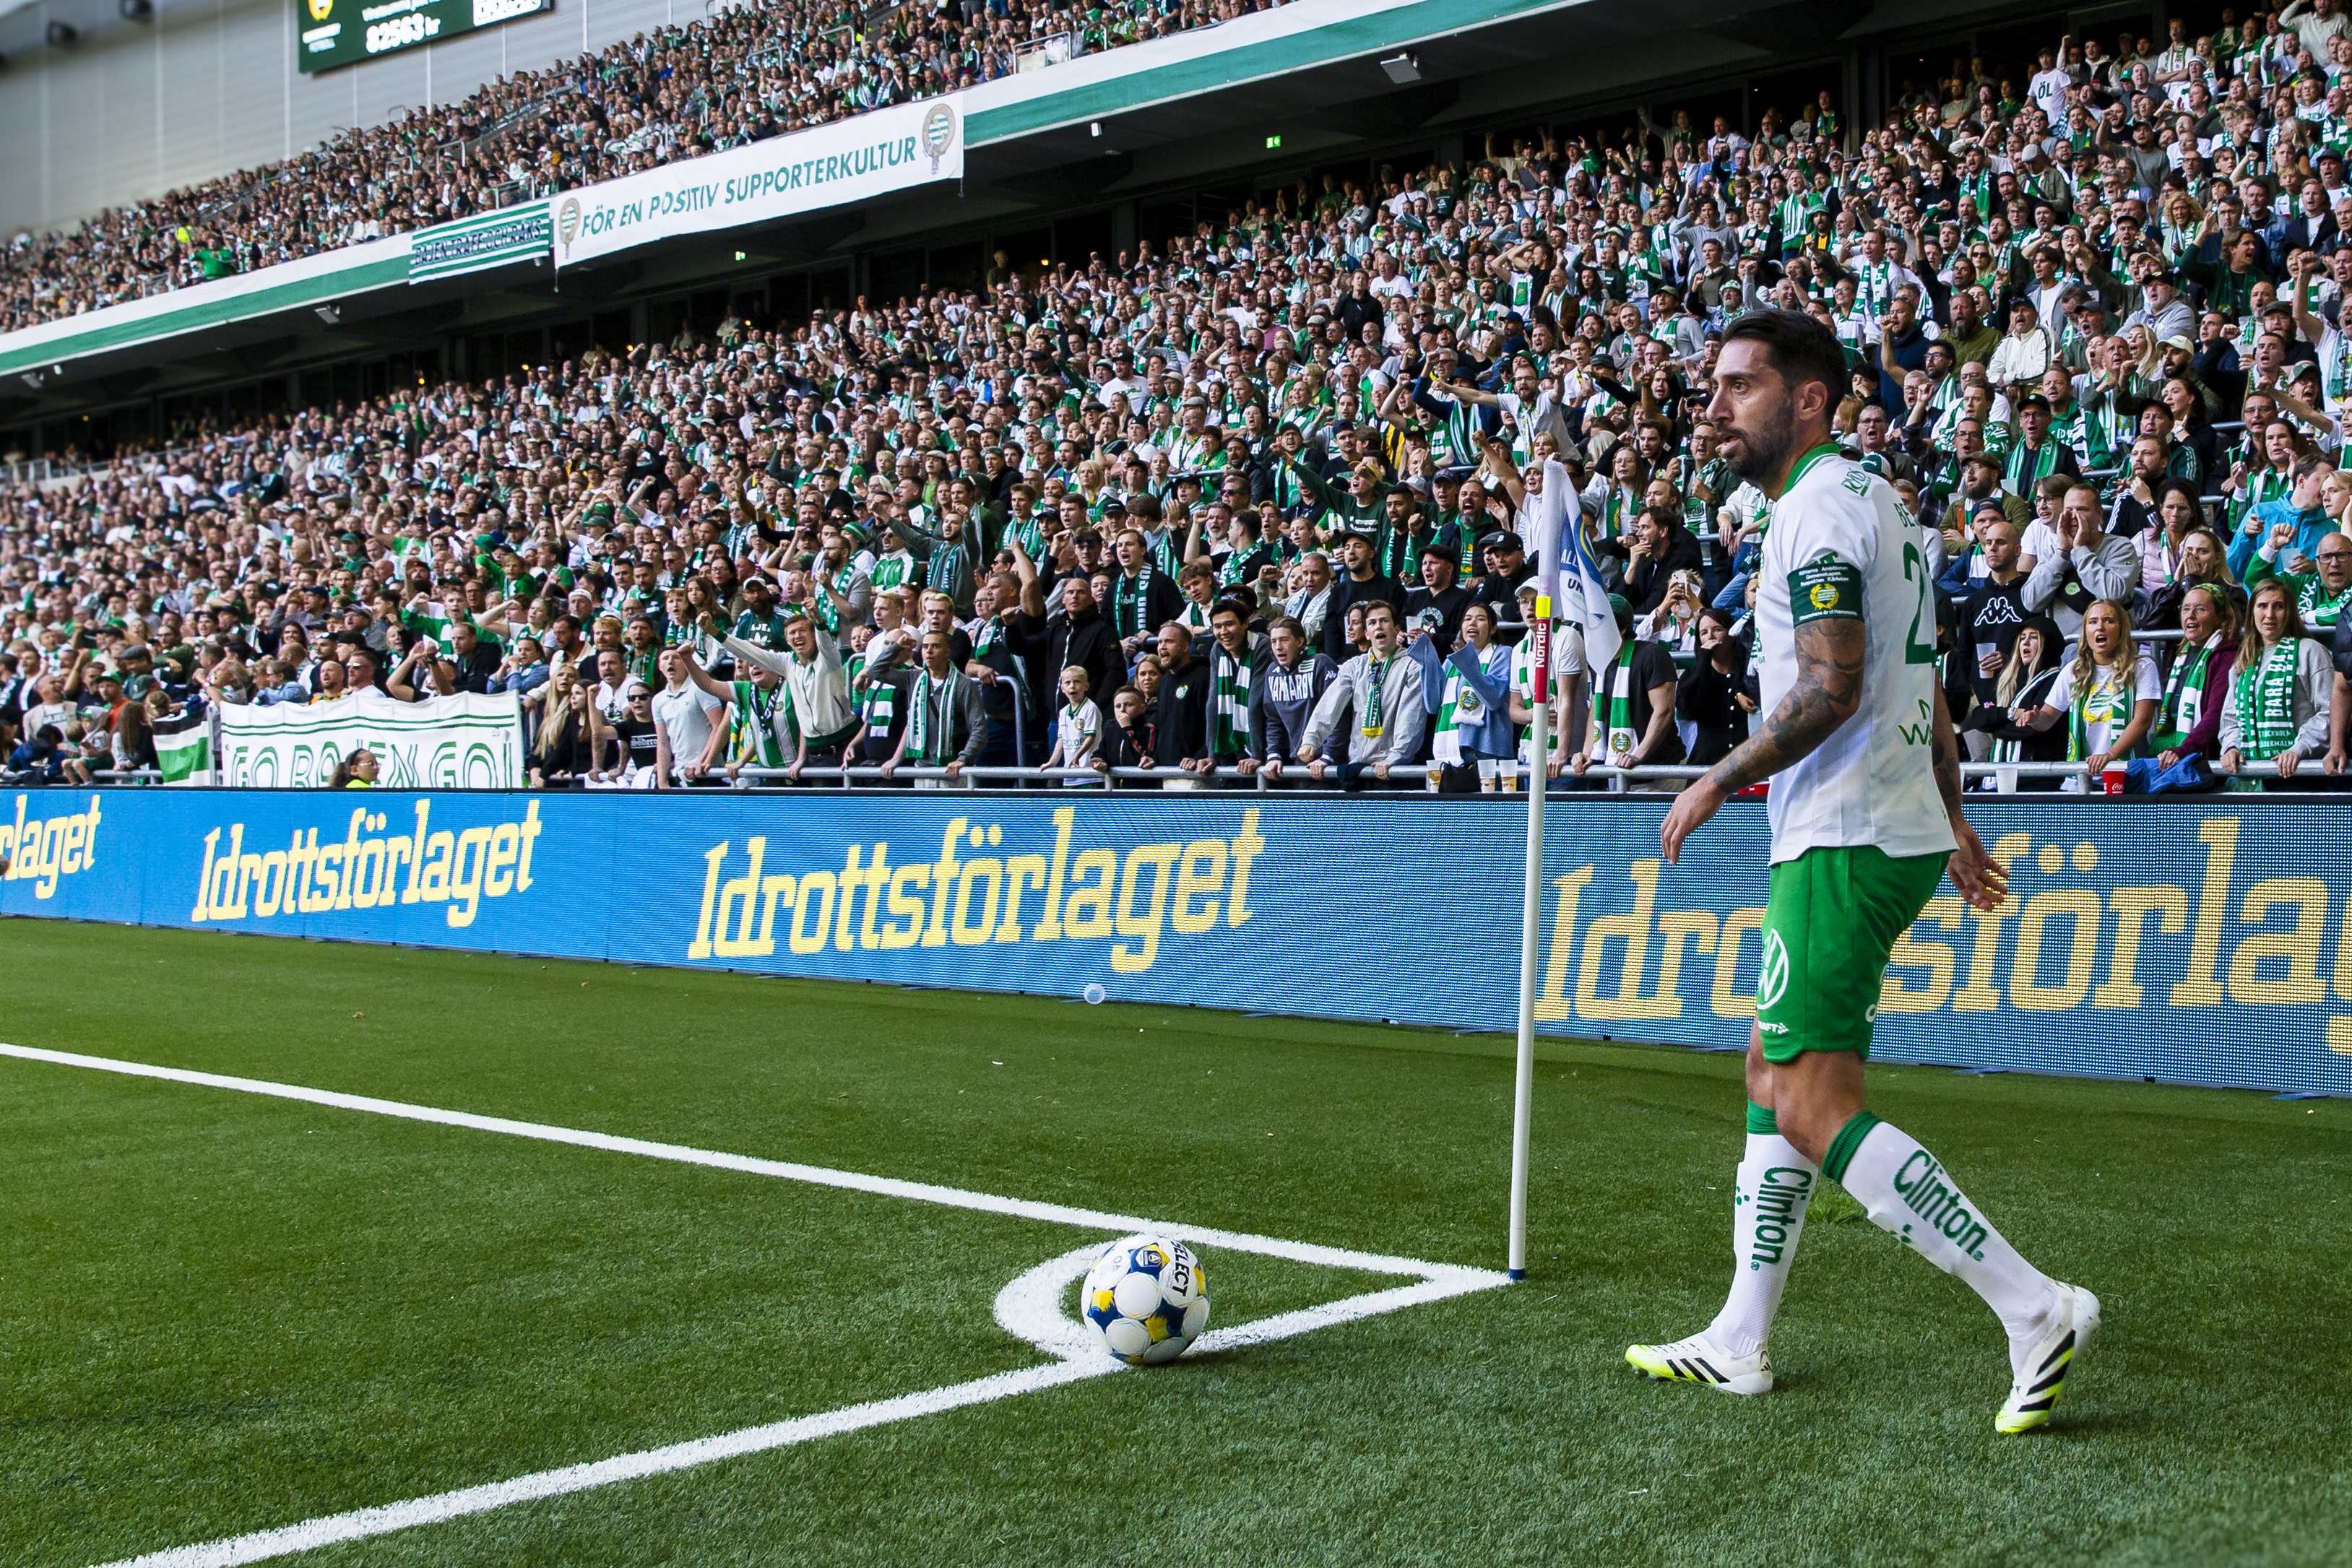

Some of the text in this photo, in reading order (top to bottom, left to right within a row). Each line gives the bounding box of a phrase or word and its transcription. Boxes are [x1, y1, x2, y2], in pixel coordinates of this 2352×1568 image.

[2038, 82, 2053, 99] ÖL
[581, 135, 917, 239] FÖR EN POSITIV SUPPORTERKULTUR
[2264, 677, 2285, 716] BARA
[192, 798, 542, 928] Idrottsförlaget
[688, 806, 1266, 973] Idrottsförlaget
[1534, 816, 2352, 1057] Idrosförla
[1170, 1240, 1190, 1297] SELECT
